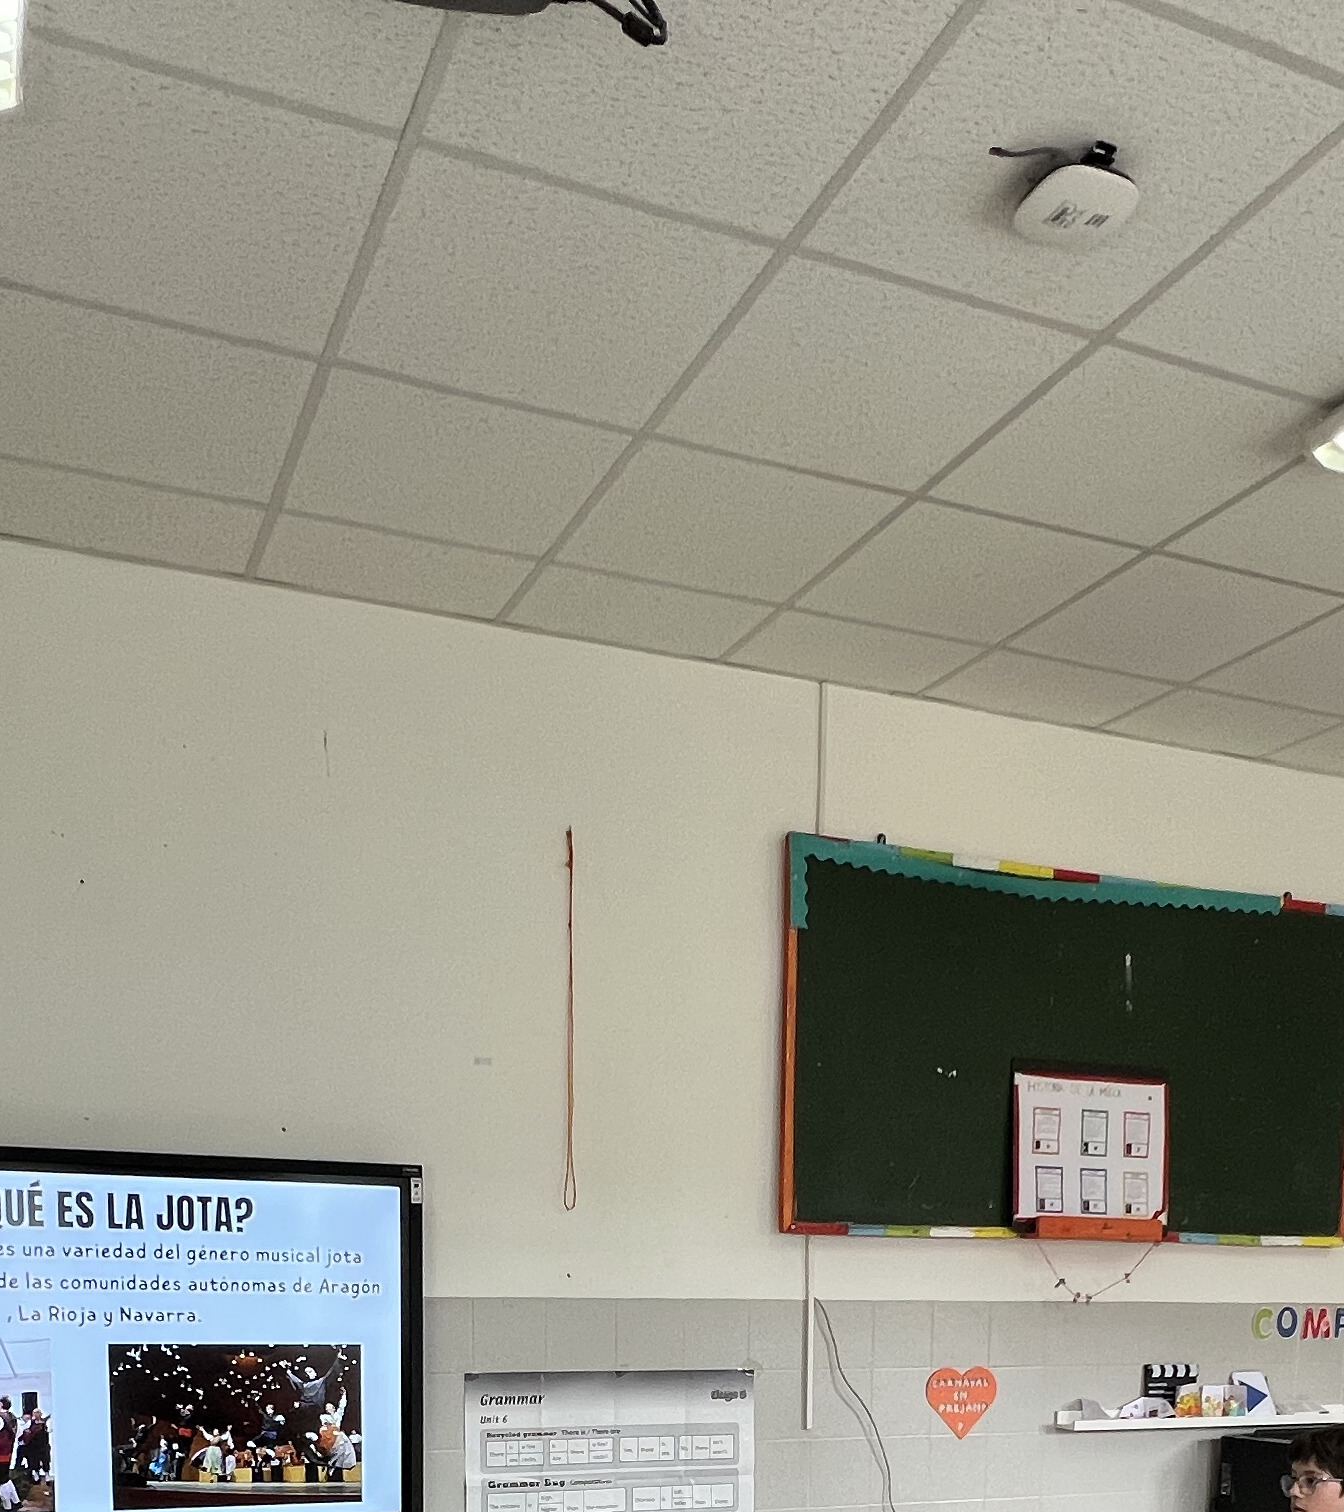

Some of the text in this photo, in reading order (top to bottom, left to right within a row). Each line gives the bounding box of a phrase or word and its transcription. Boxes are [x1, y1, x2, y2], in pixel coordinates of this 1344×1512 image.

[57, 1191, 95, 1229] ES
[107, 1192, 145, 1231] LA
[156, 1194, 254, 1233] JOTA?
[22, 1244, 55, 1257] una
[62, 1241, 147, 1259] variedad
[153, 1243, 180, 1260] del
[187, 1245, 250, 1265] género
[256, 1246, 320, 1263] musical
[325, 1248, 362, 1268] jota
[25, 1272, 53, 1290] las
[59, 1274, 181, 1292] comunidades
[188, 1276, 287, 1293] autónomas
[292, 1277, 313, 1294] de
[319, 1278, 381, 1299] Aragón
[18, 1305, 42, 1322] La
[48, 1305, 97, 1327] Rioja
[103, 1310, 114, 1327] y
[119, 1307, 203, 1323] Navarra.
[479, 1393, 546, 1406] Grammar
[479, 1415, 508, 1425] Unit 6
